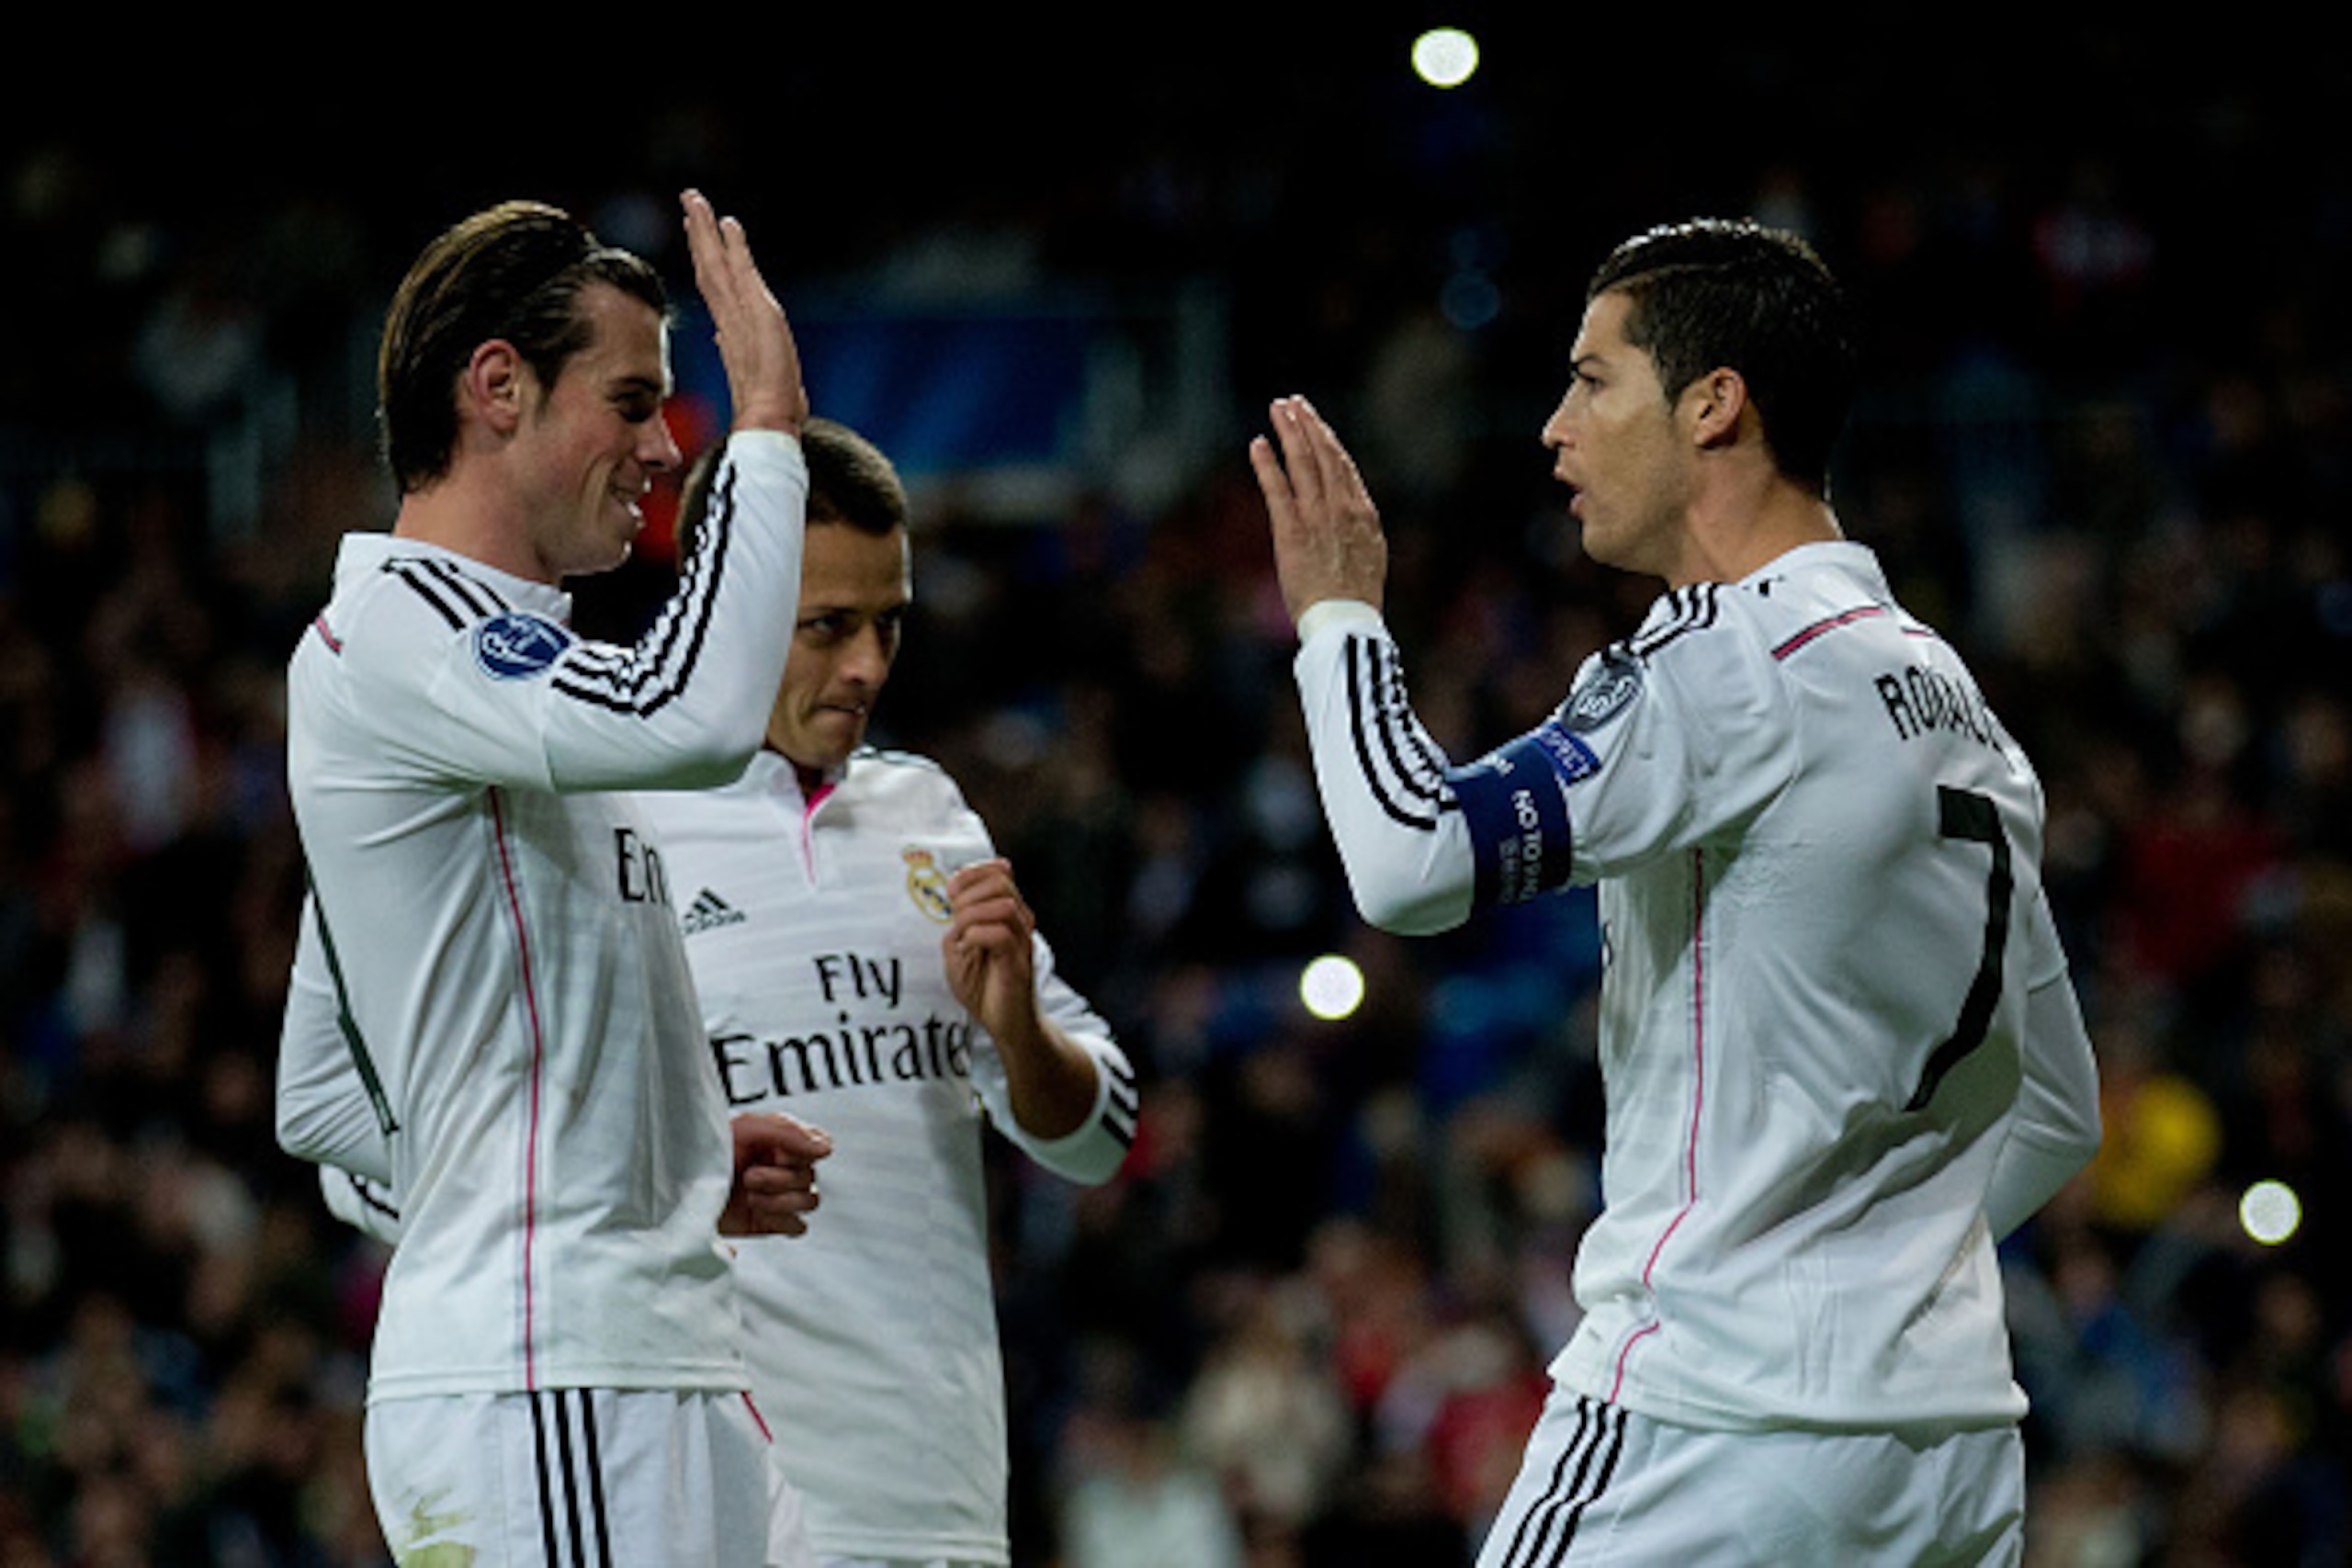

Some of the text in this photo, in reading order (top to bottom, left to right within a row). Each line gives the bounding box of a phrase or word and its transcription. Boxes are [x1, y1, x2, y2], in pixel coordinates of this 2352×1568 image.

[814, 952, 902, 1008] Fly
[1902, 784, 2014, 1112] 7
[710, 1011, 970, 1106] Emirate
